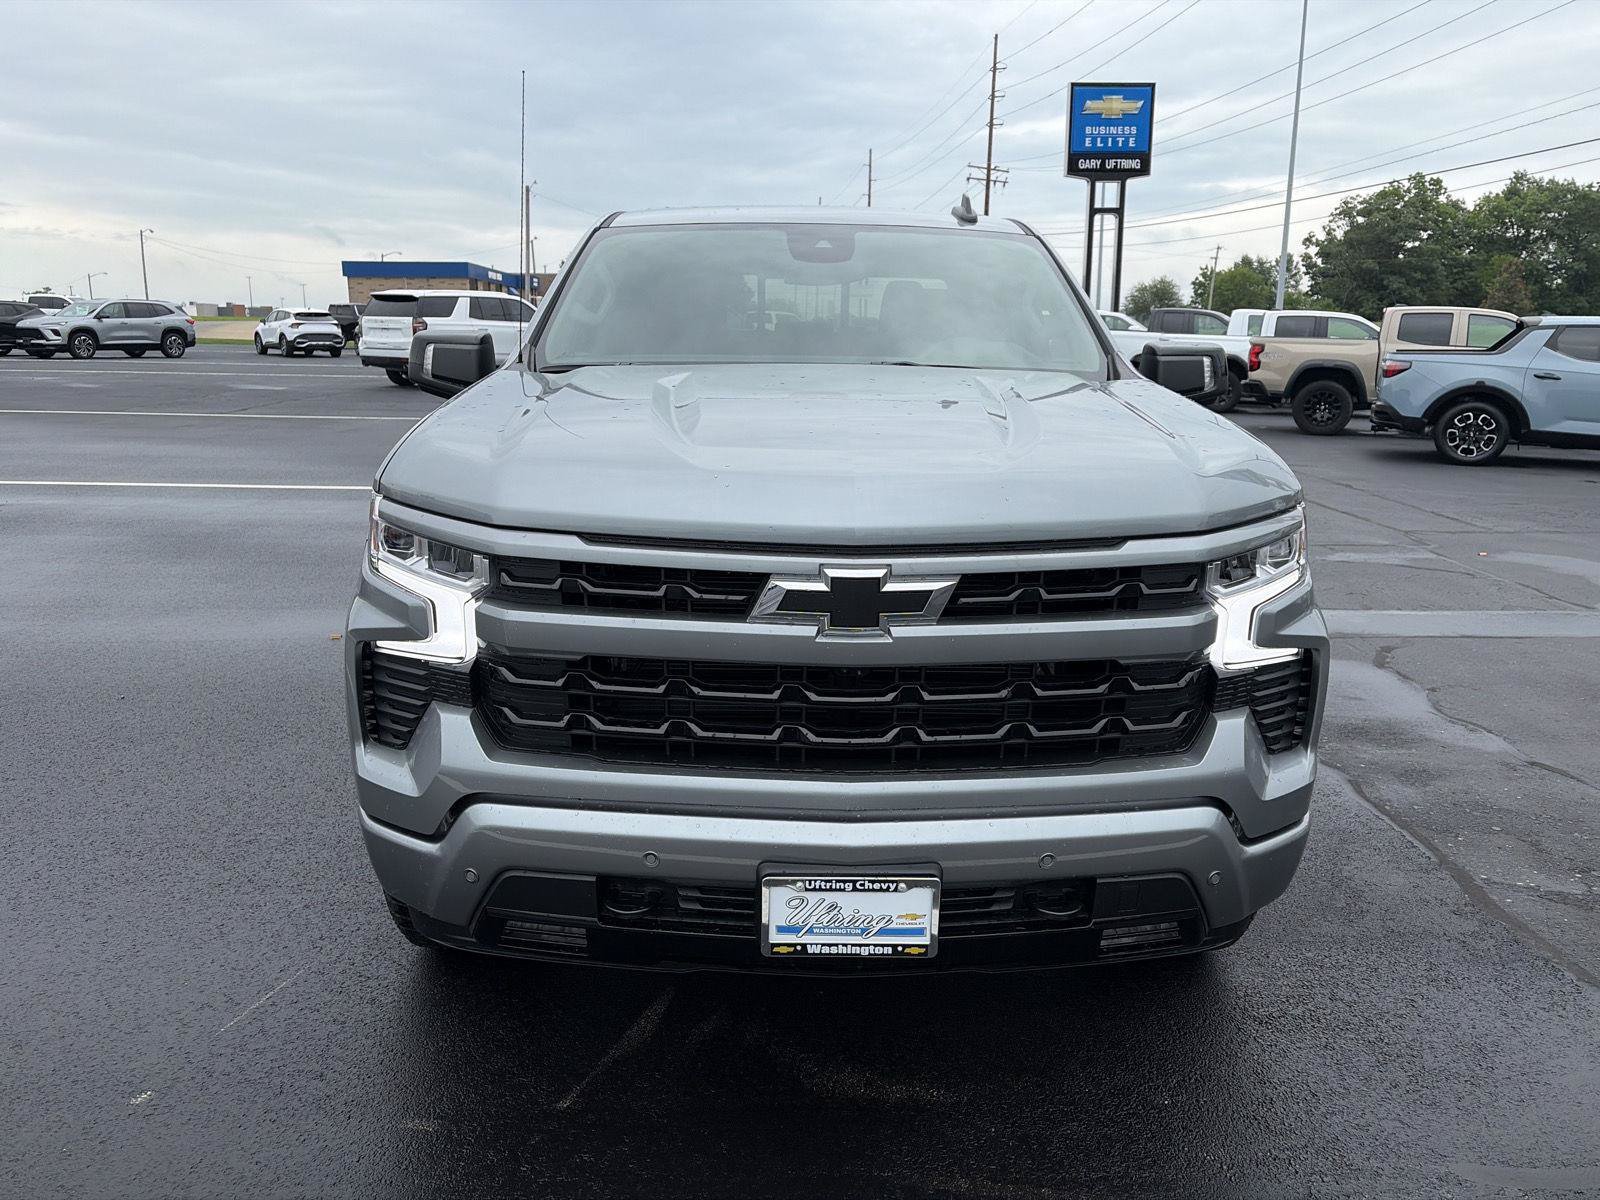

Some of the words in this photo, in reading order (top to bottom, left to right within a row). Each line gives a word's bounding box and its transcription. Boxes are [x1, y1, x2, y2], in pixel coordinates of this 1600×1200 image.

[1085, 126, 1137, 134] BUSINESS
[1085, 137, 1136, 146] ELITE
[1078, 159, 1102, 169] GARY
[1105, 159, 1141, 169] UFTRING
[805, 880, 853, 891] Uftring
[856, 880, 897, 892] Chevy
[806, 944, 892, 955] Washington
